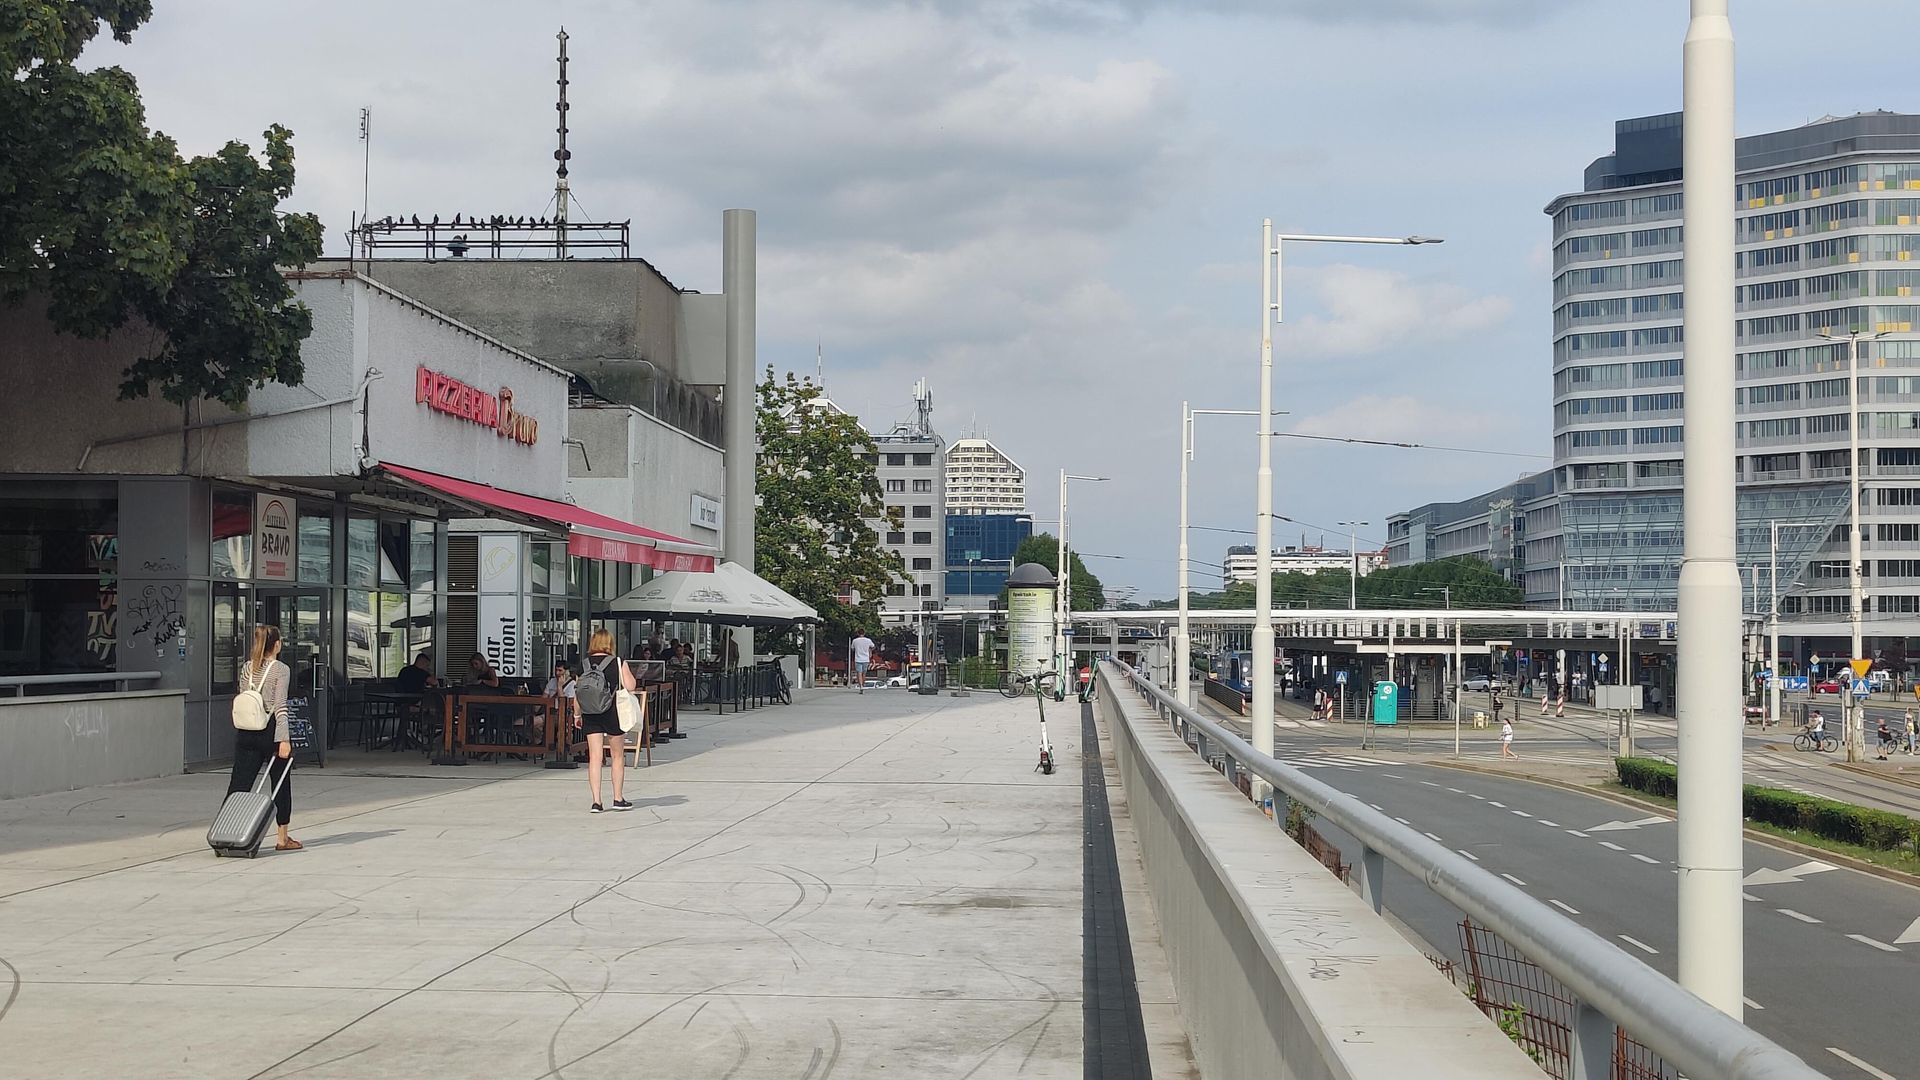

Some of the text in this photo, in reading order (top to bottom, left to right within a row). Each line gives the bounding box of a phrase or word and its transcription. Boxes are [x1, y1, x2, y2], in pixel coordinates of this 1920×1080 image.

[416, 366, 499, 430] PIZZERIA
[262, 532, 290, 557] BRAVO
[500, 617, 516, 678] emont
